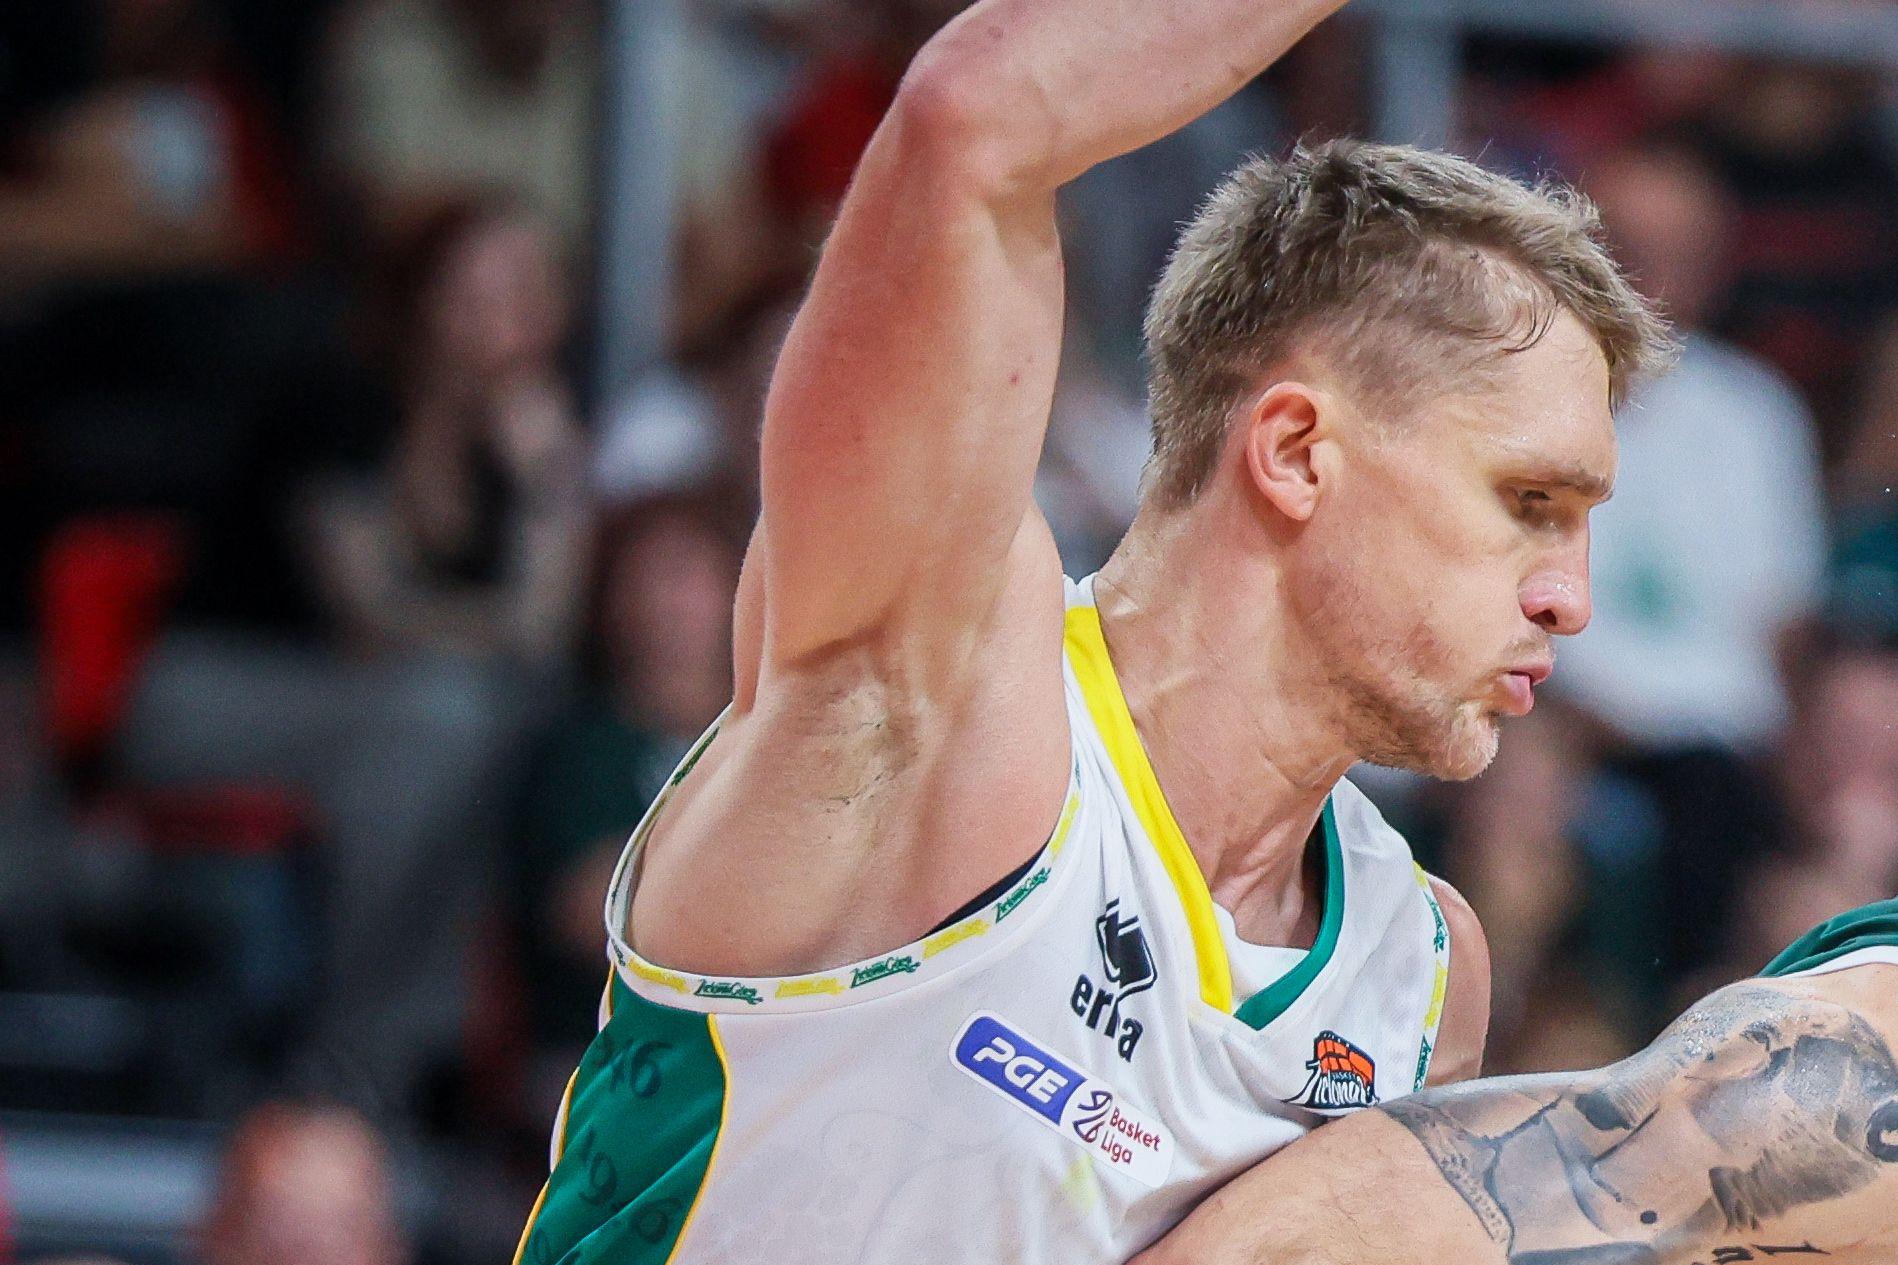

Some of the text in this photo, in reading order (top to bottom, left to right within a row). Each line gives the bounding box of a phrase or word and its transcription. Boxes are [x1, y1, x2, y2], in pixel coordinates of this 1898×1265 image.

[973, 1037, 1069, 1104] PGE
[1101, 1132, 1133, 1163] Liga
[1110, 1106, 1161, 1151] Basket
